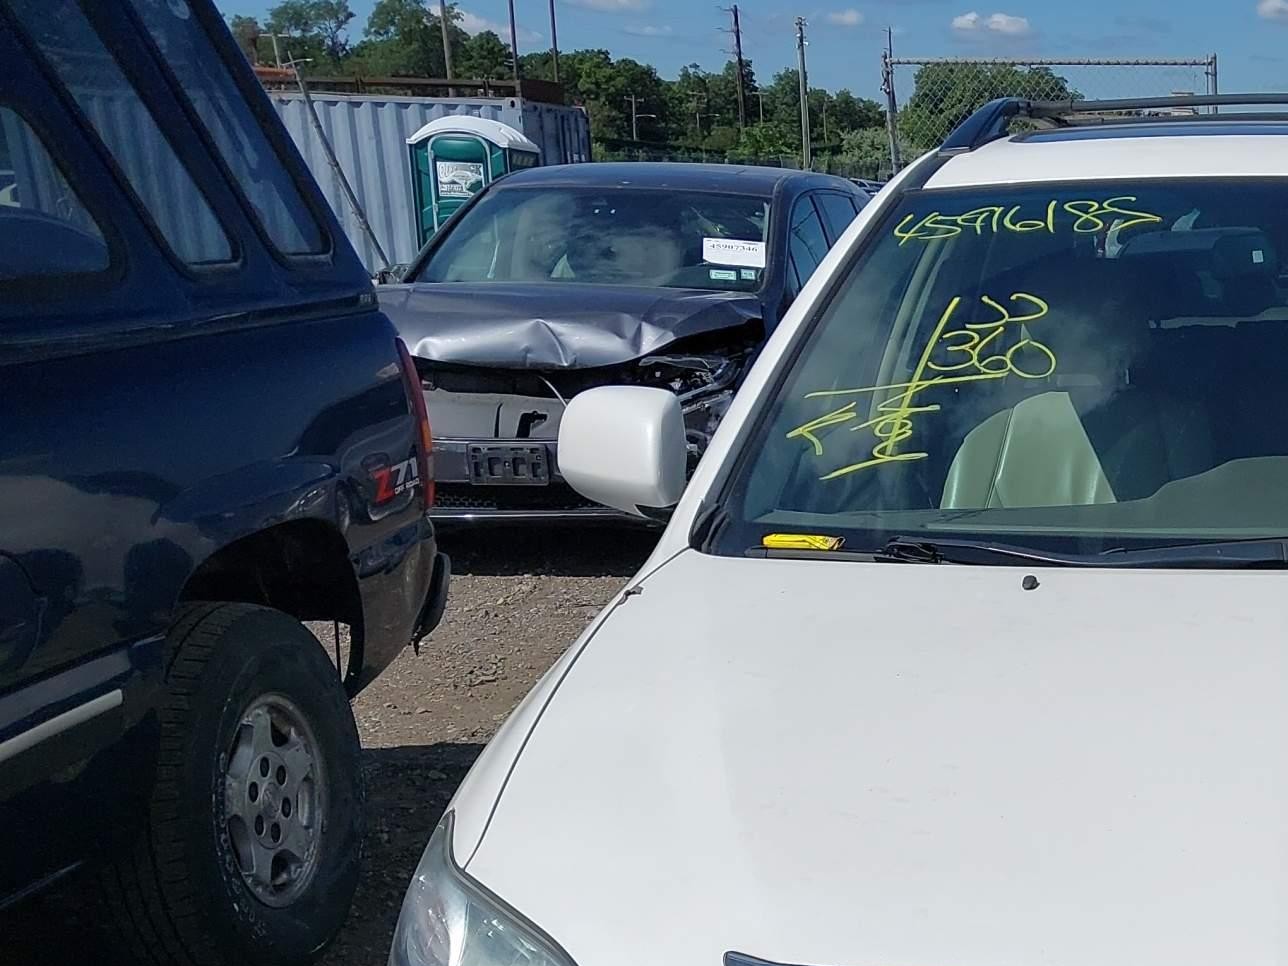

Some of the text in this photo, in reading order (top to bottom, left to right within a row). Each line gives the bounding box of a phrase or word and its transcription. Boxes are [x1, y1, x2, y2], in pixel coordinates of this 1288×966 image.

[893, 196, 1163, 246] 45916185
[927, 326, 1057, 379] 360
[373, 457, 418, 503] Z71
